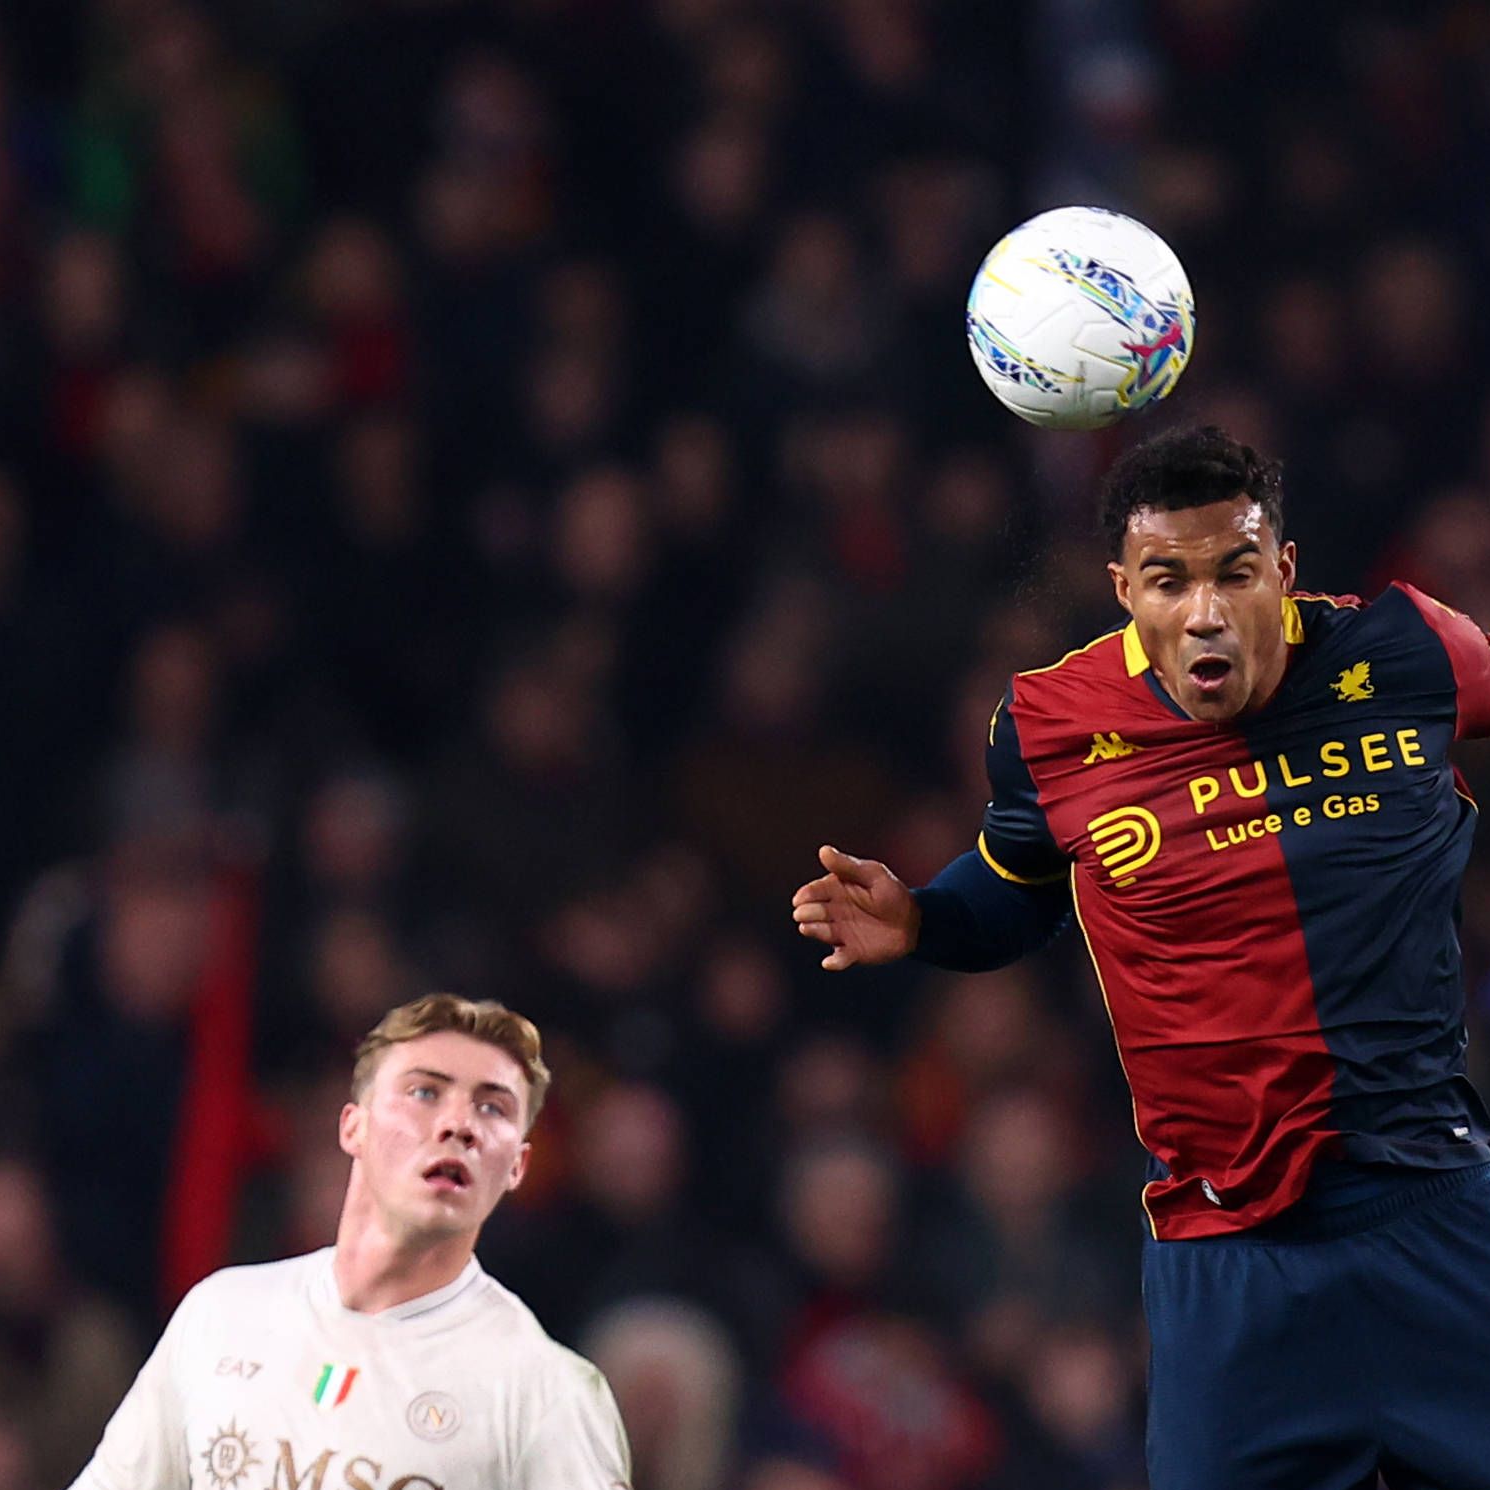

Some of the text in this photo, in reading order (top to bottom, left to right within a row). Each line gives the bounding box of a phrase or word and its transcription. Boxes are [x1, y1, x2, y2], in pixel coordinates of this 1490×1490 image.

[1188, 728, 1426, 815] PULSEE
[1206, 794, 1380, 851] Luce e Gas
[215, 1357, 262, 1379] EA7
